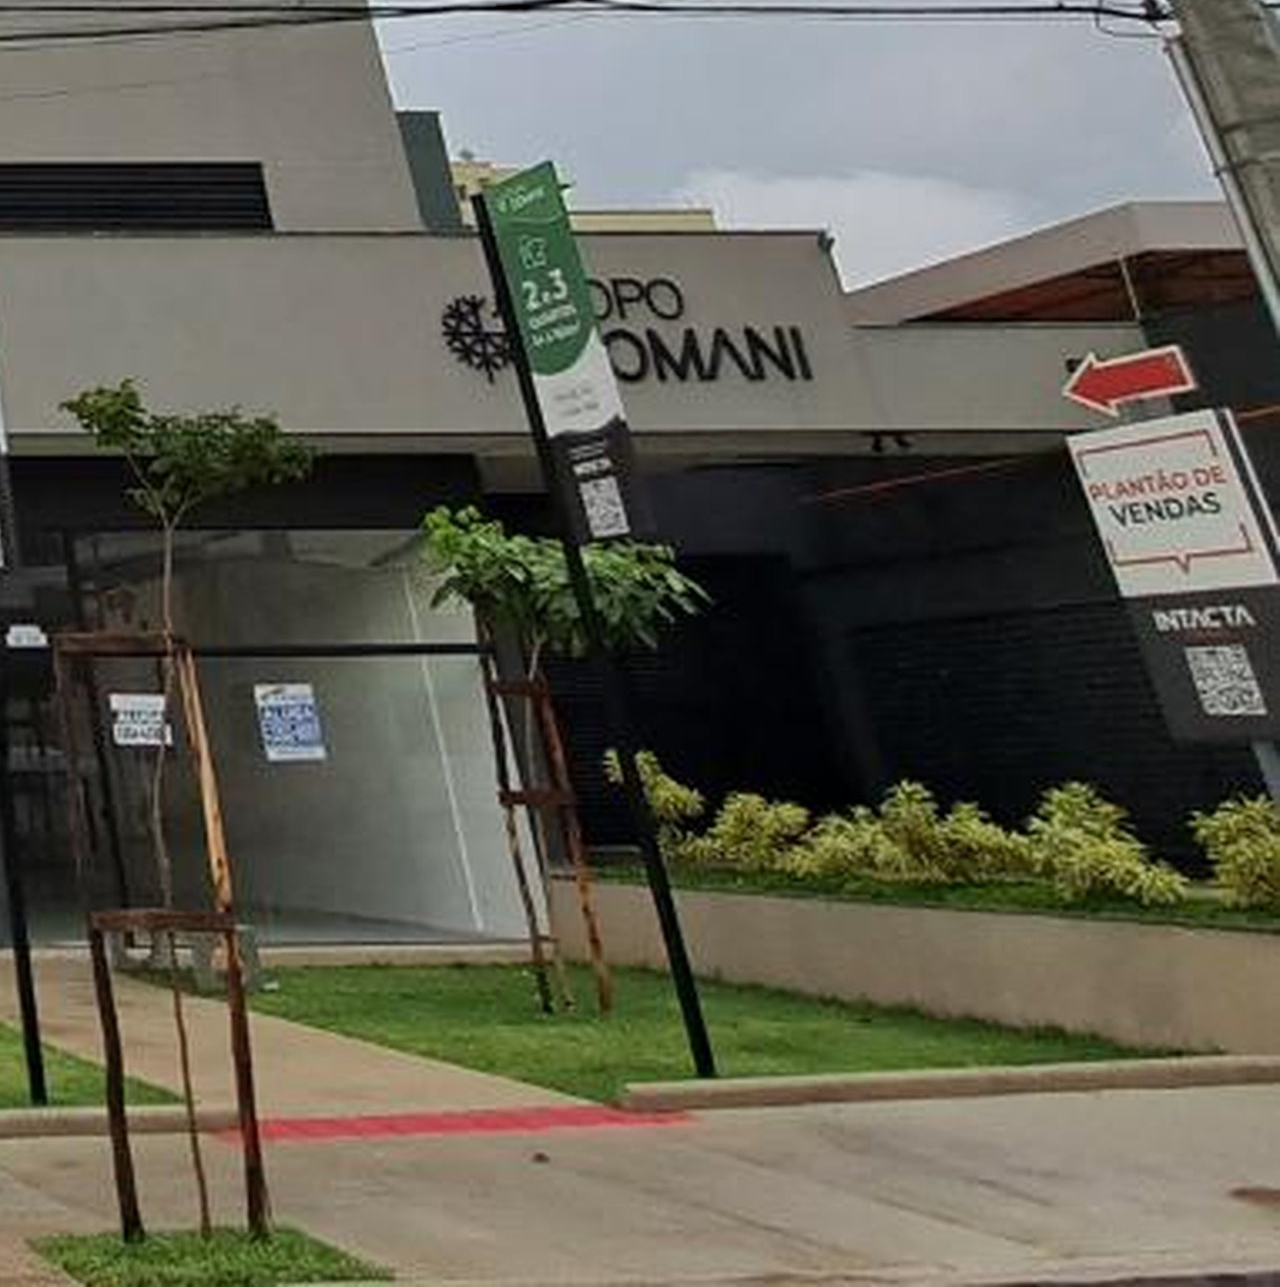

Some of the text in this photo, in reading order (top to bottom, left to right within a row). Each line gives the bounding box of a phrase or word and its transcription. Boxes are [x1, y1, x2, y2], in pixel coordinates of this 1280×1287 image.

[585, 278, 684, 320] OPO
[602, 326, 813, 382] OMANI
[1089, 465, 1227, 500] PLANTÃO DE
[1108, 492, 1221, 527] VENDAS
[1152, 605, 1256, 632] INTACTA
